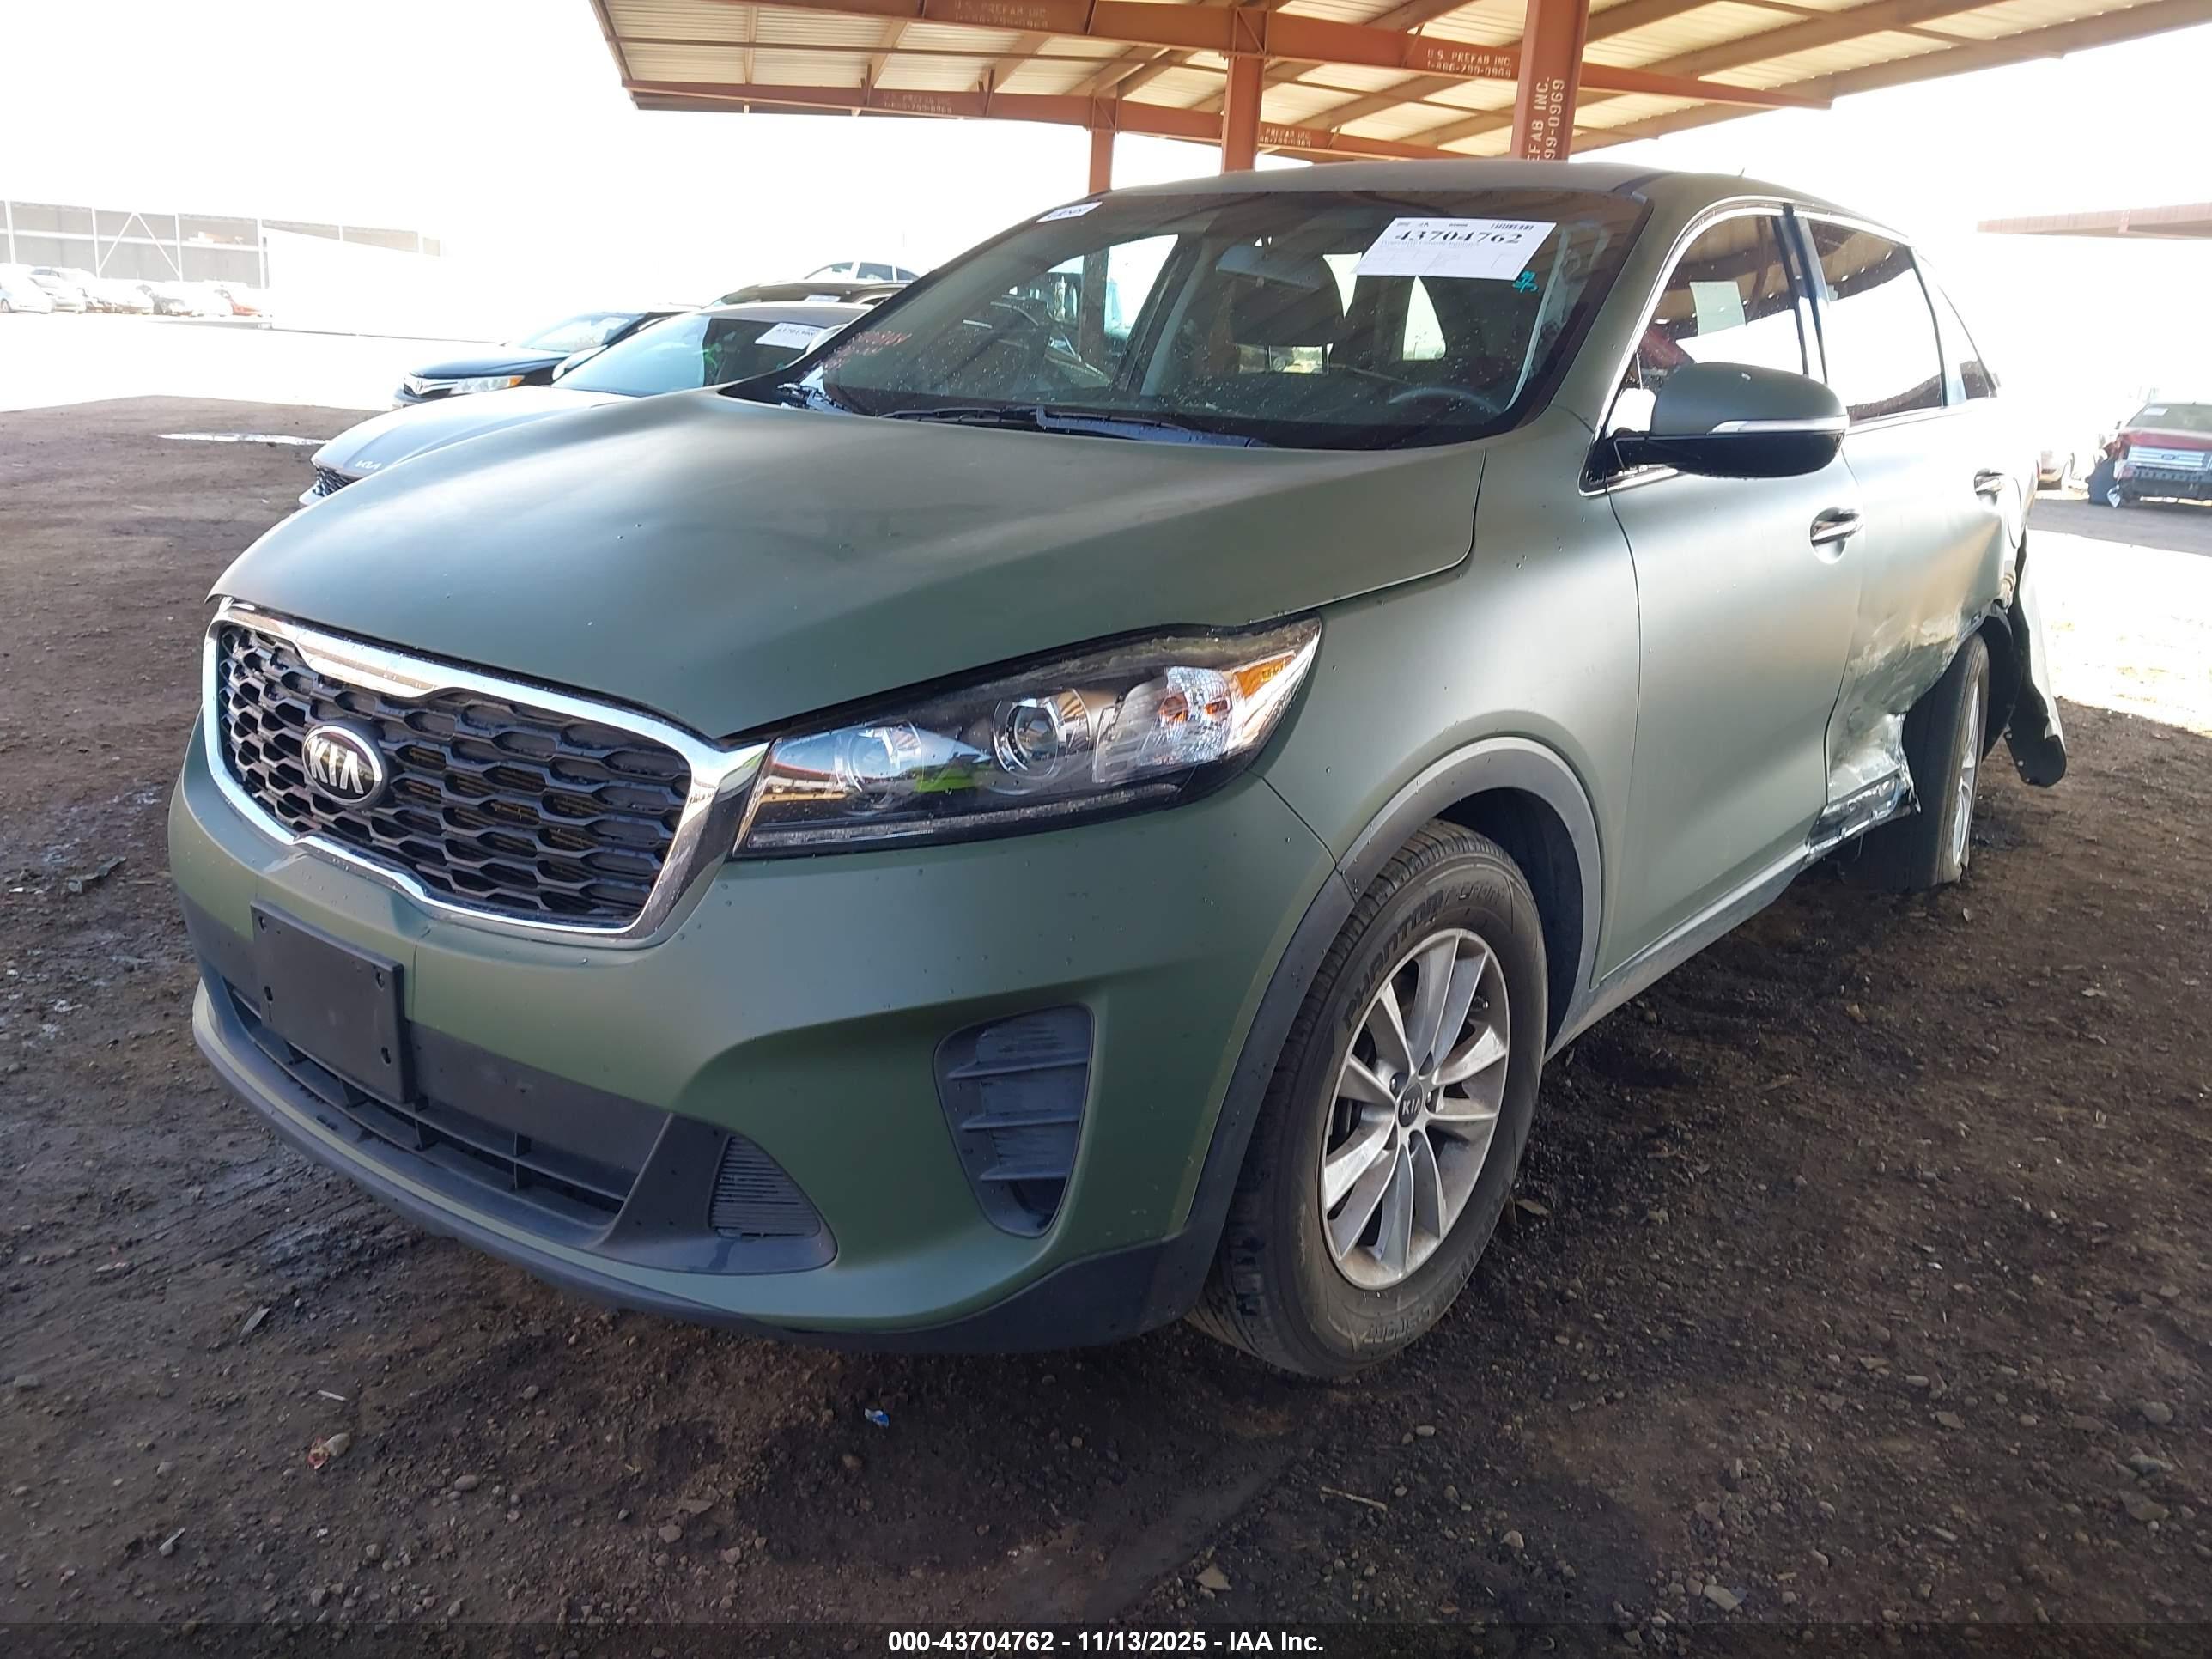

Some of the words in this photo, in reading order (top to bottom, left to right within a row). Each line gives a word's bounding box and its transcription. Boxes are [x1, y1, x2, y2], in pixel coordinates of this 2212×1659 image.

[1451, 52, 1490, 64] PREFAB
[1395, 230, 1522, 244] 43704762
[307, 735, 365, 795] KIA
[1401, 1097, 1421, 1116] KIA
